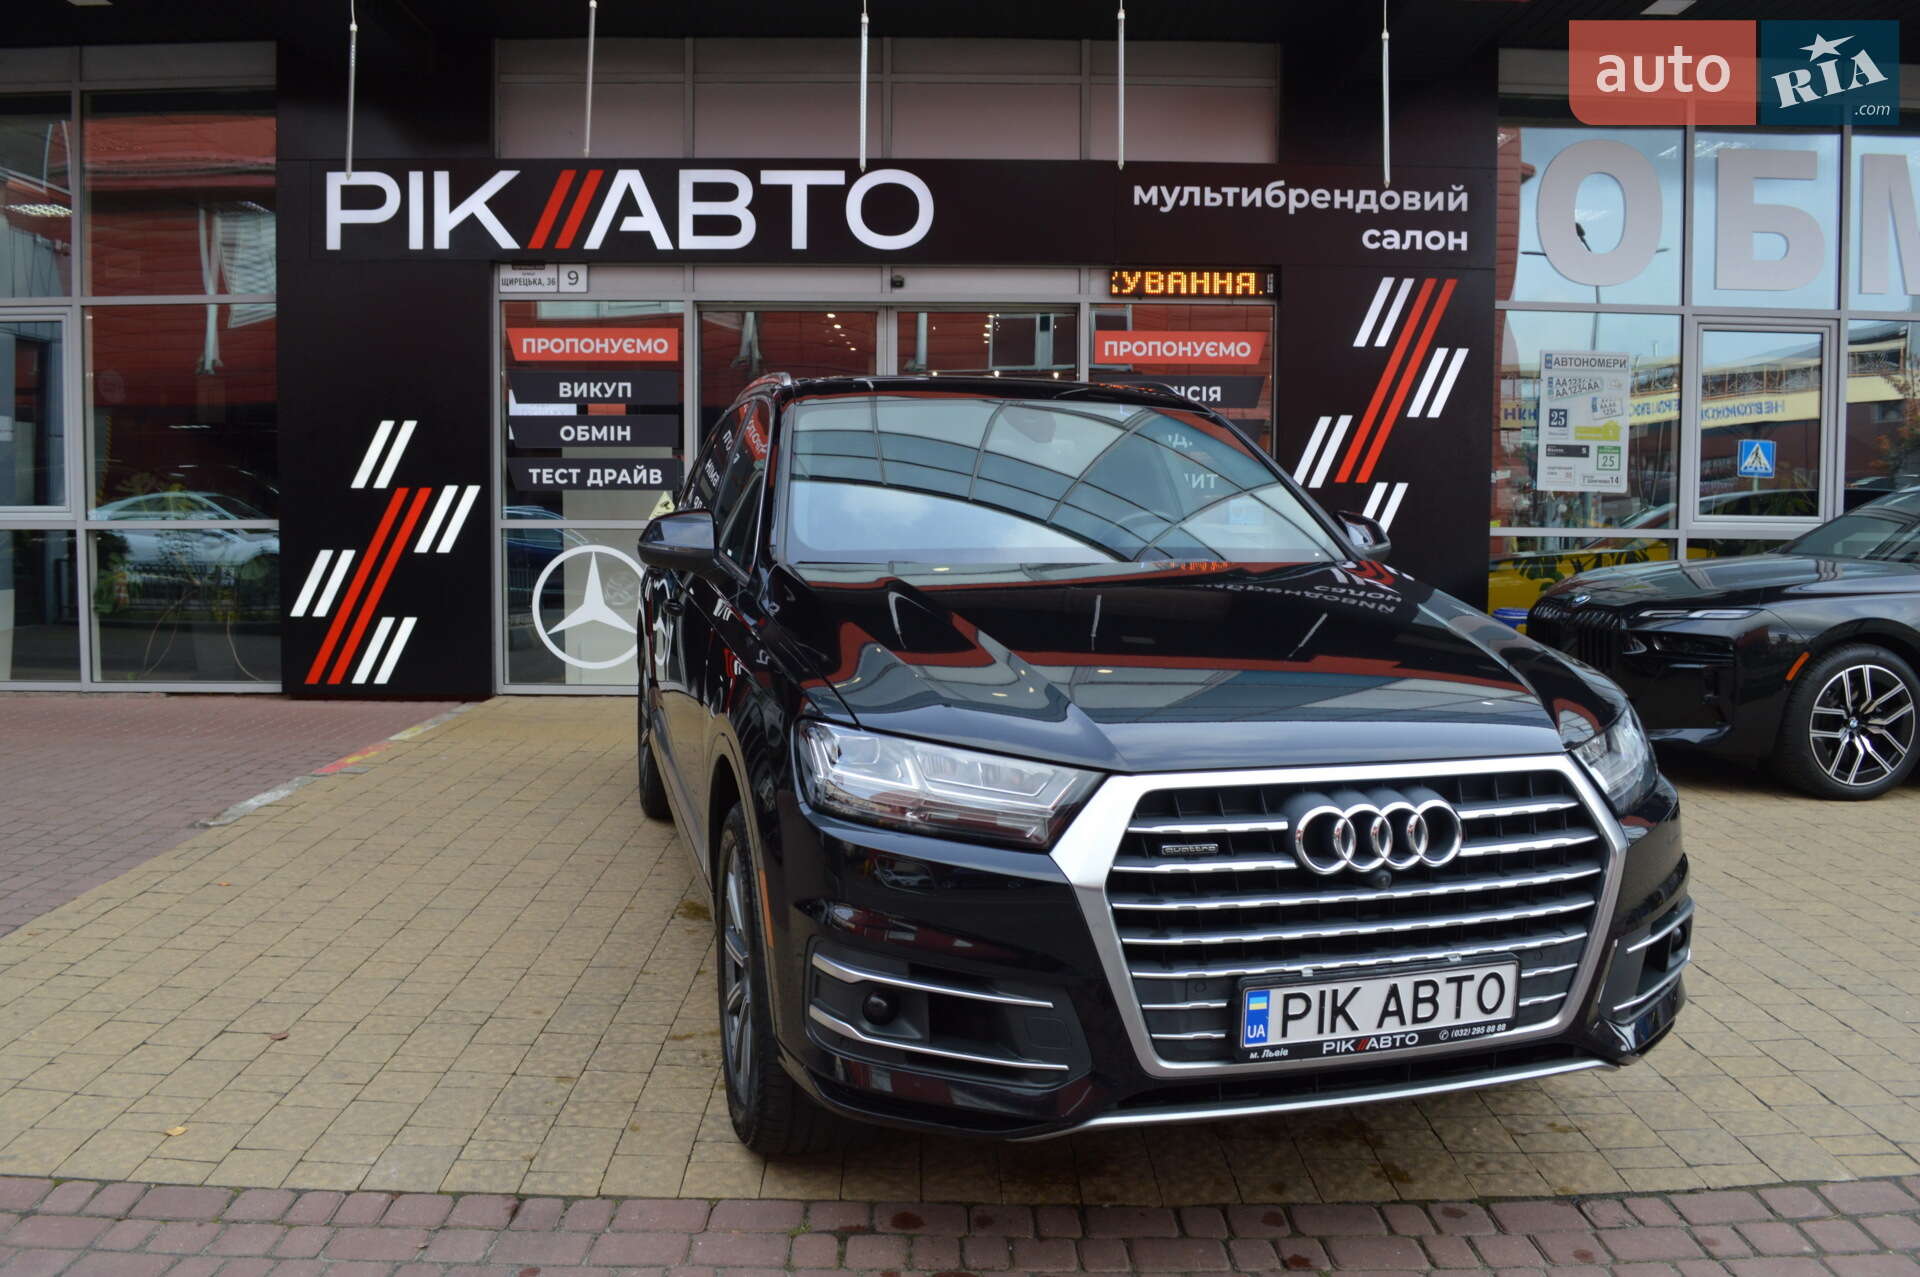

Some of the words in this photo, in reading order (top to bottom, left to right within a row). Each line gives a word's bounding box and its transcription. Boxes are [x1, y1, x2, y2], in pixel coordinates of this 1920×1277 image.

[1133, 180, 1469, 215] мультибрендовий
[1361, 228, 1469, 251] салон
[567, 270, 580, 286] 9
[521, 336, 670, 356] ПРОПОНУЄМО
[1103, 340, 1252, 358] ПРОПОНУЄМО
[1553, 356, 1627, 369] АВТОНОМЕРИ
[558, 382, 633, 399] ВИКУП
[1550, 411, 1566, 427] 25
[559, 425, 632, 442] ОБМІН
[1601, 455, 1616, 468] 25
[528, 468, 581, 485] ТЕСТ
[586, 465, 664, 488] ДРАЙВ
[1280, 985, 1362, 1039] РІК
[1376, 971, 1507, 1030] АВТО
[1247, 1024, 1266, 1039] UA
